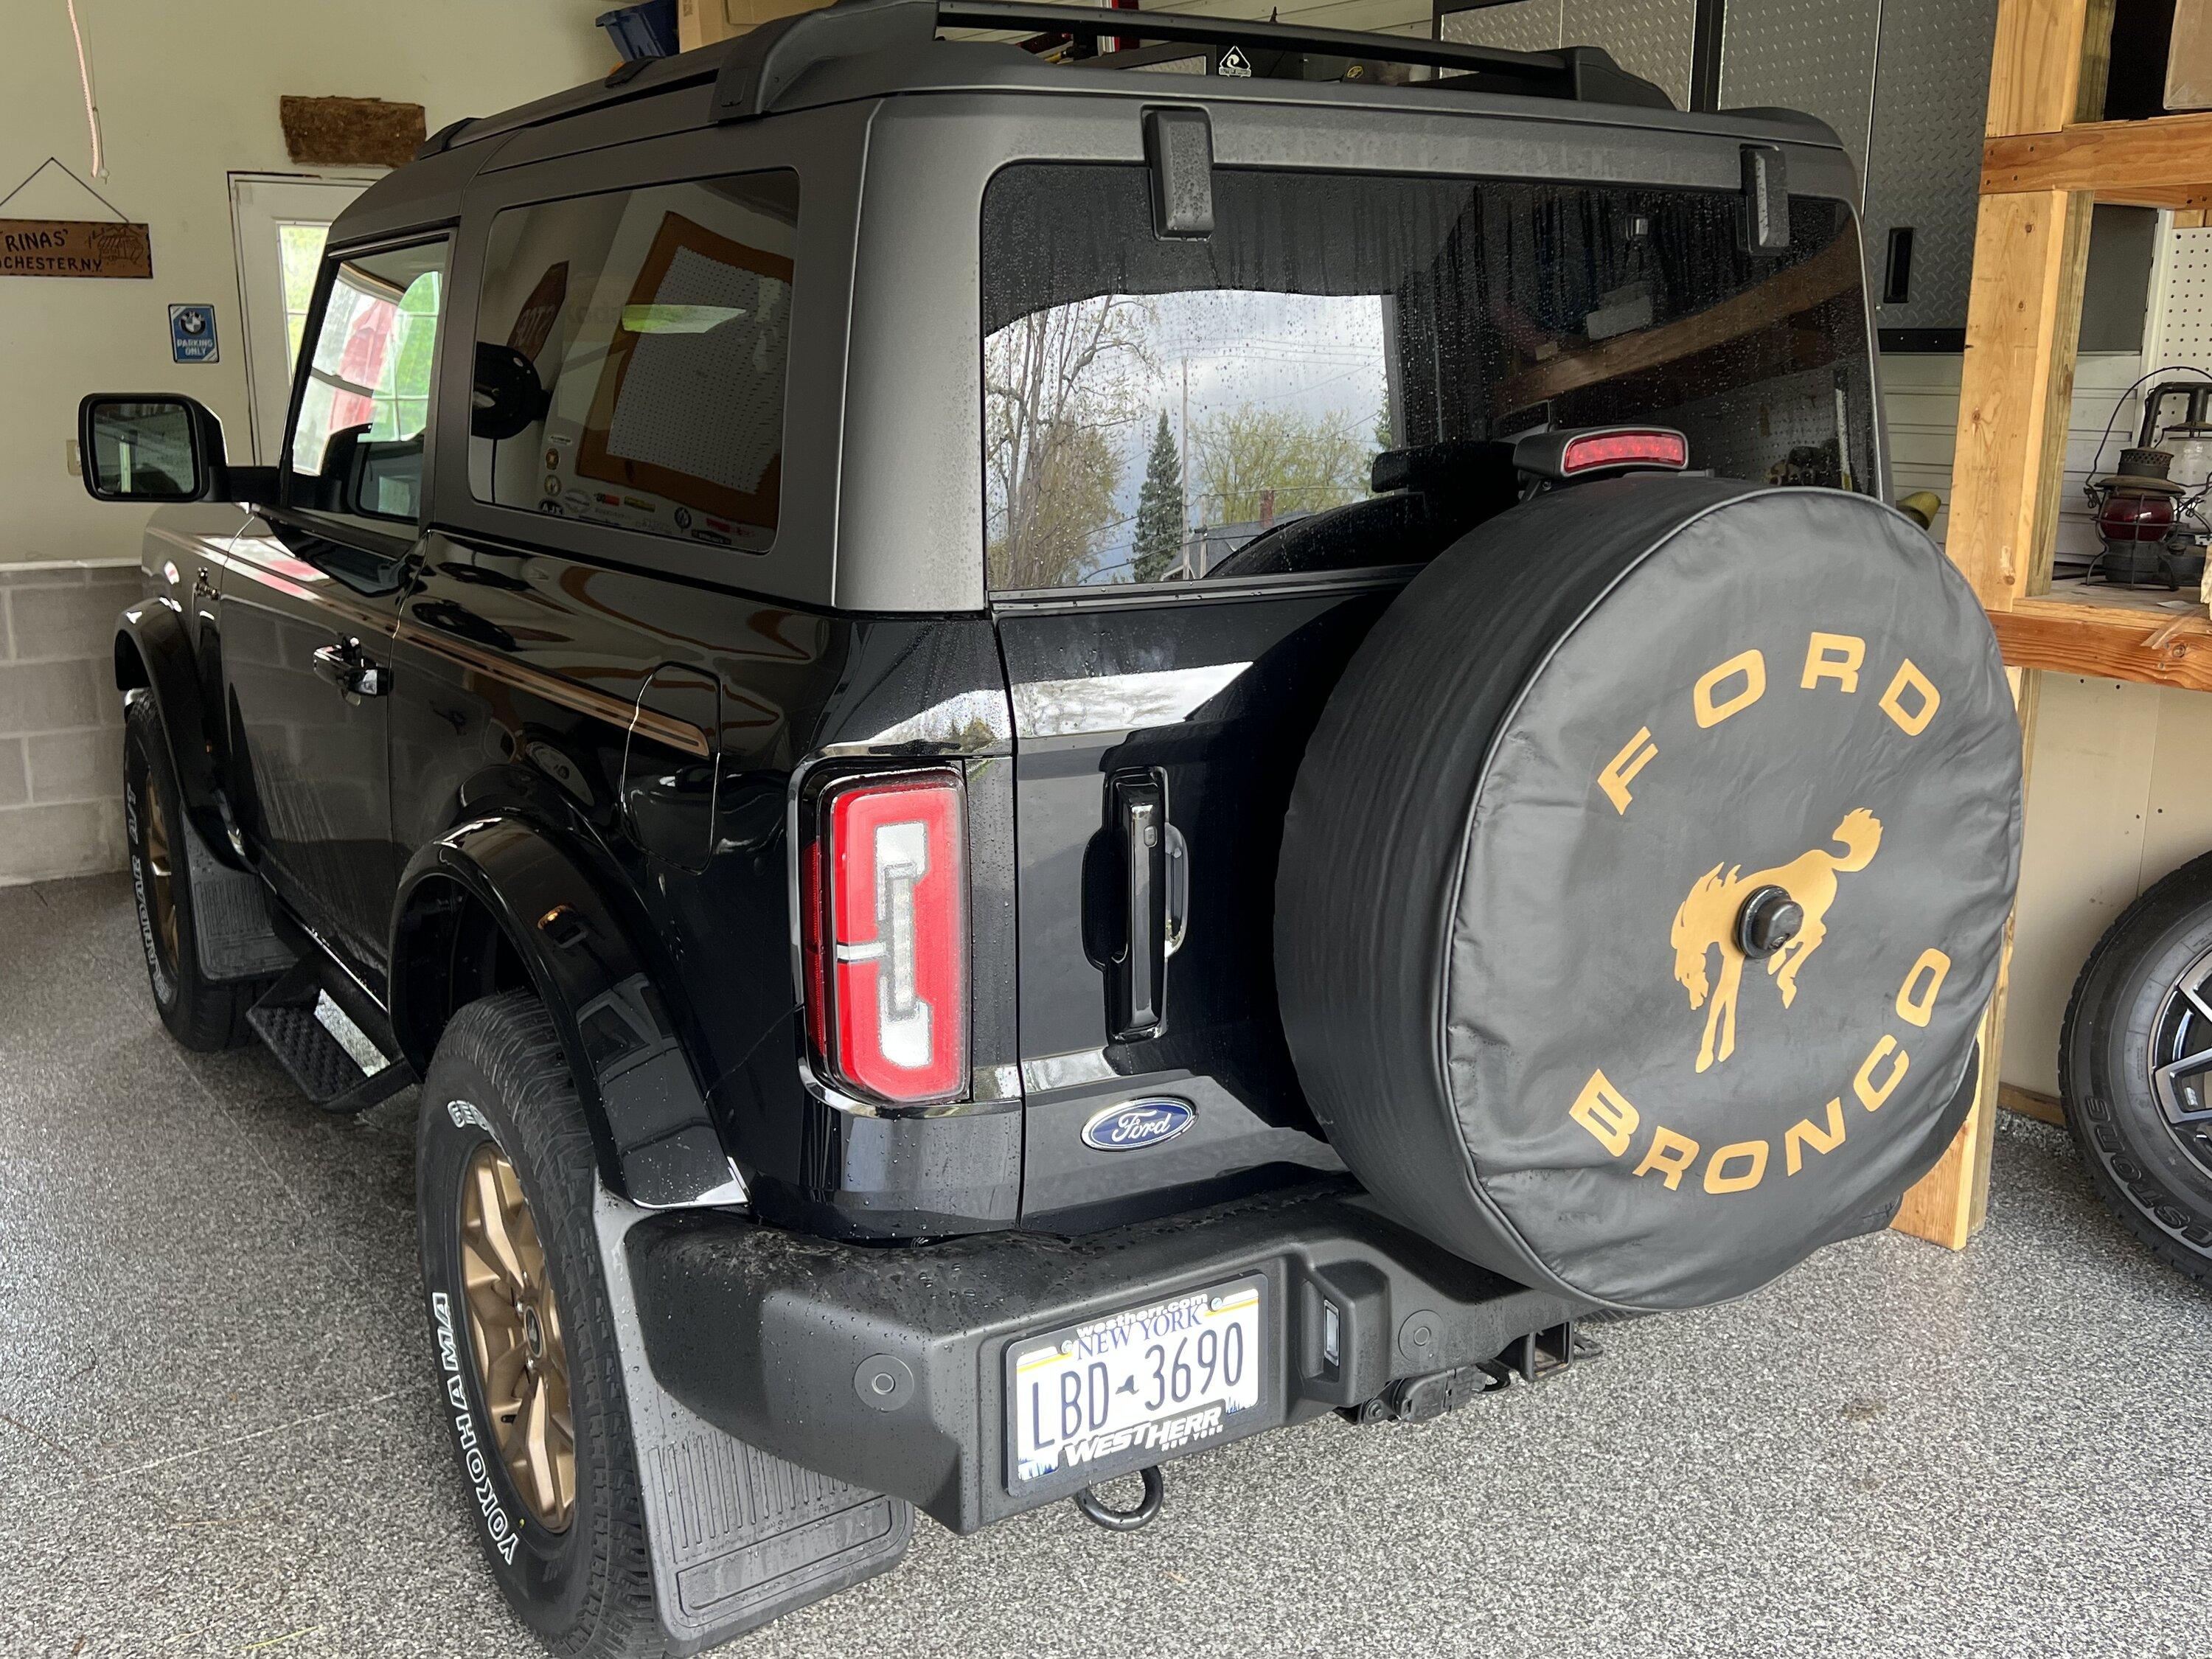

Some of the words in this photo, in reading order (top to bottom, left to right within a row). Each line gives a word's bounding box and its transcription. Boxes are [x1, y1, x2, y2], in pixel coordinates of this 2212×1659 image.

[0, 229, 69, 252] RINAS'
[177, 339, 213, 347] PARKING
[185, 347, 206, 356] ONLY
[1597, 631, 1941, 815] FORD
[1568, 947, 1951, 1194] BRONCO
[1111, 1110, 1172, 1142] Ford
[1076, 1293, 1208, 1339] westherr.com
[1077, 1327, 1132, 1360] NEW
[1140, 1304, 1203, 1340] YORK
[1032, 1361, 1110, 1450] LBD
[1144, 1321, 1243, 1411] 3690
[432, 1292, 519, 1565] YOKOHAMA
[1161, 1436, 1188, 1452] NEW
[1192, 1424, 1224, 1442] YORK
